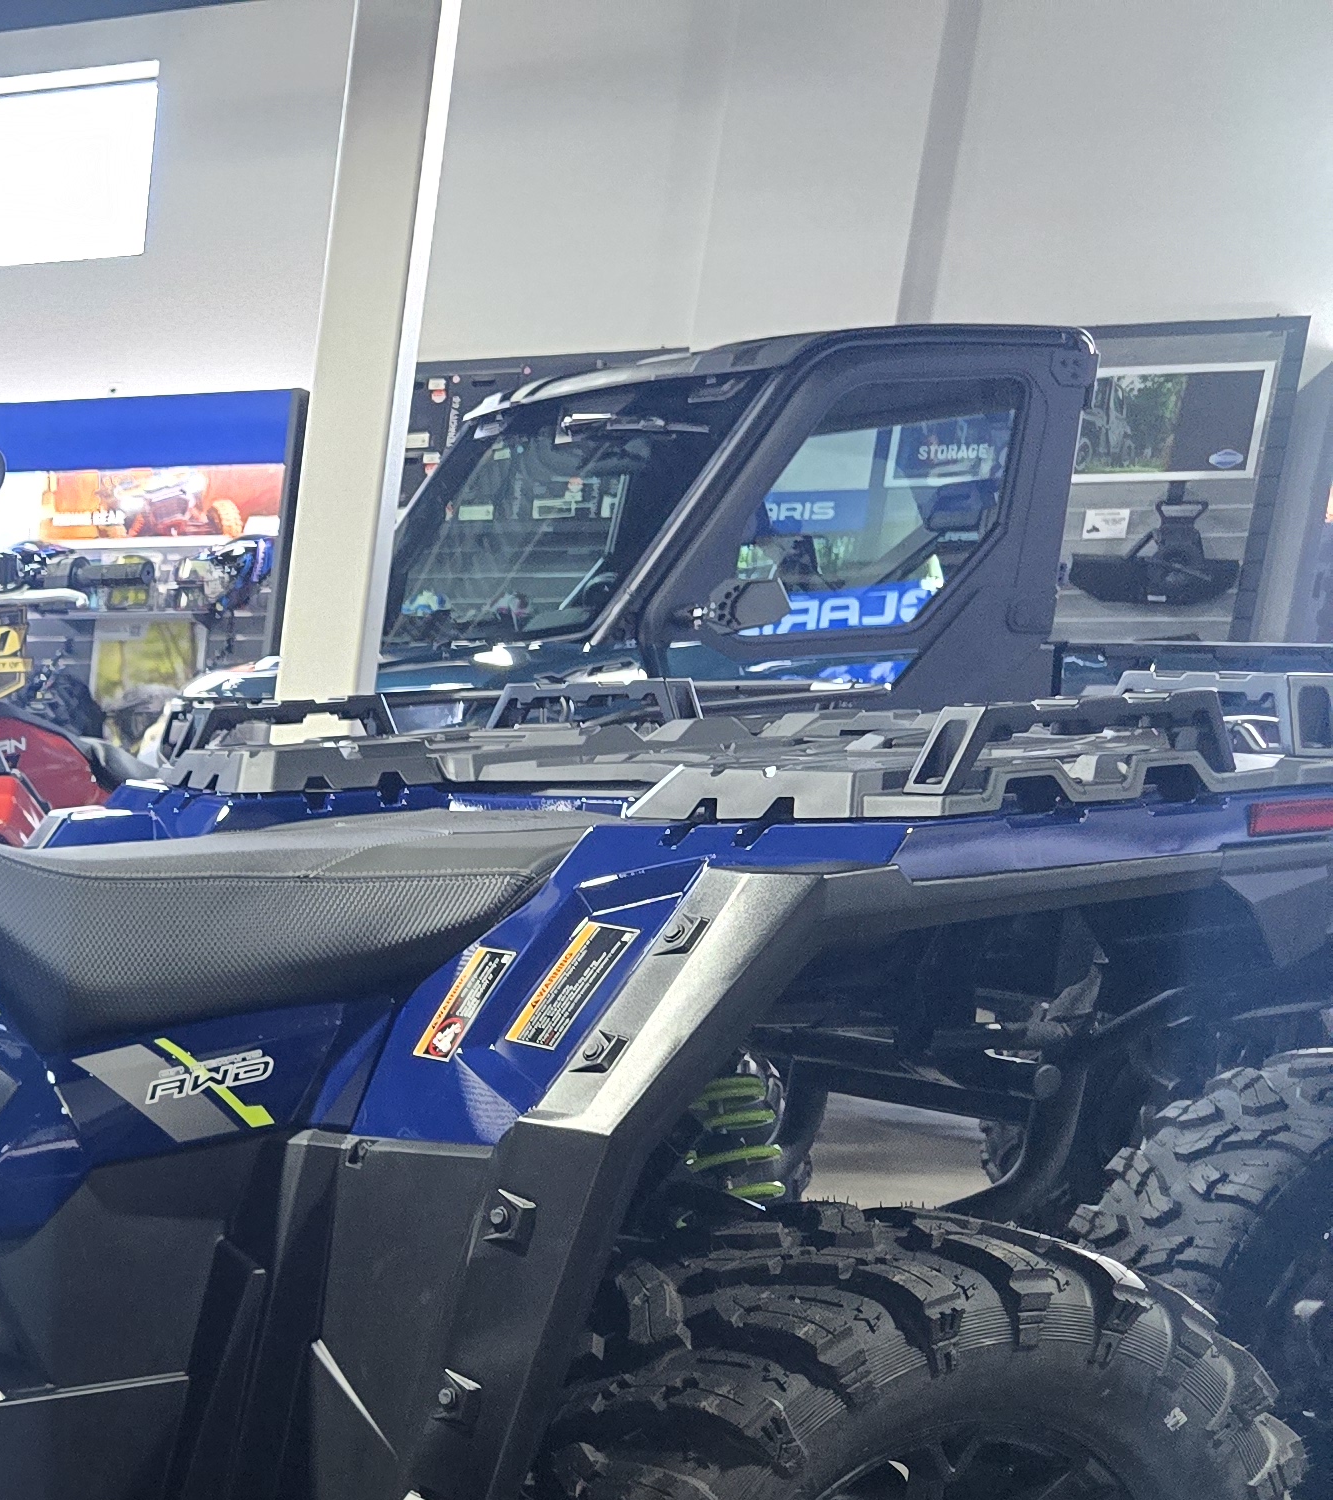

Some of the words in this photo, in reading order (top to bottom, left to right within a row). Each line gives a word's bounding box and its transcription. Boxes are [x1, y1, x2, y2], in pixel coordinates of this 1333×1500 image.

[917, 443, 989, 460] STORAGE
[9, 661, 22, 670] OF
[144, 1056, 275, 1104] AWD
